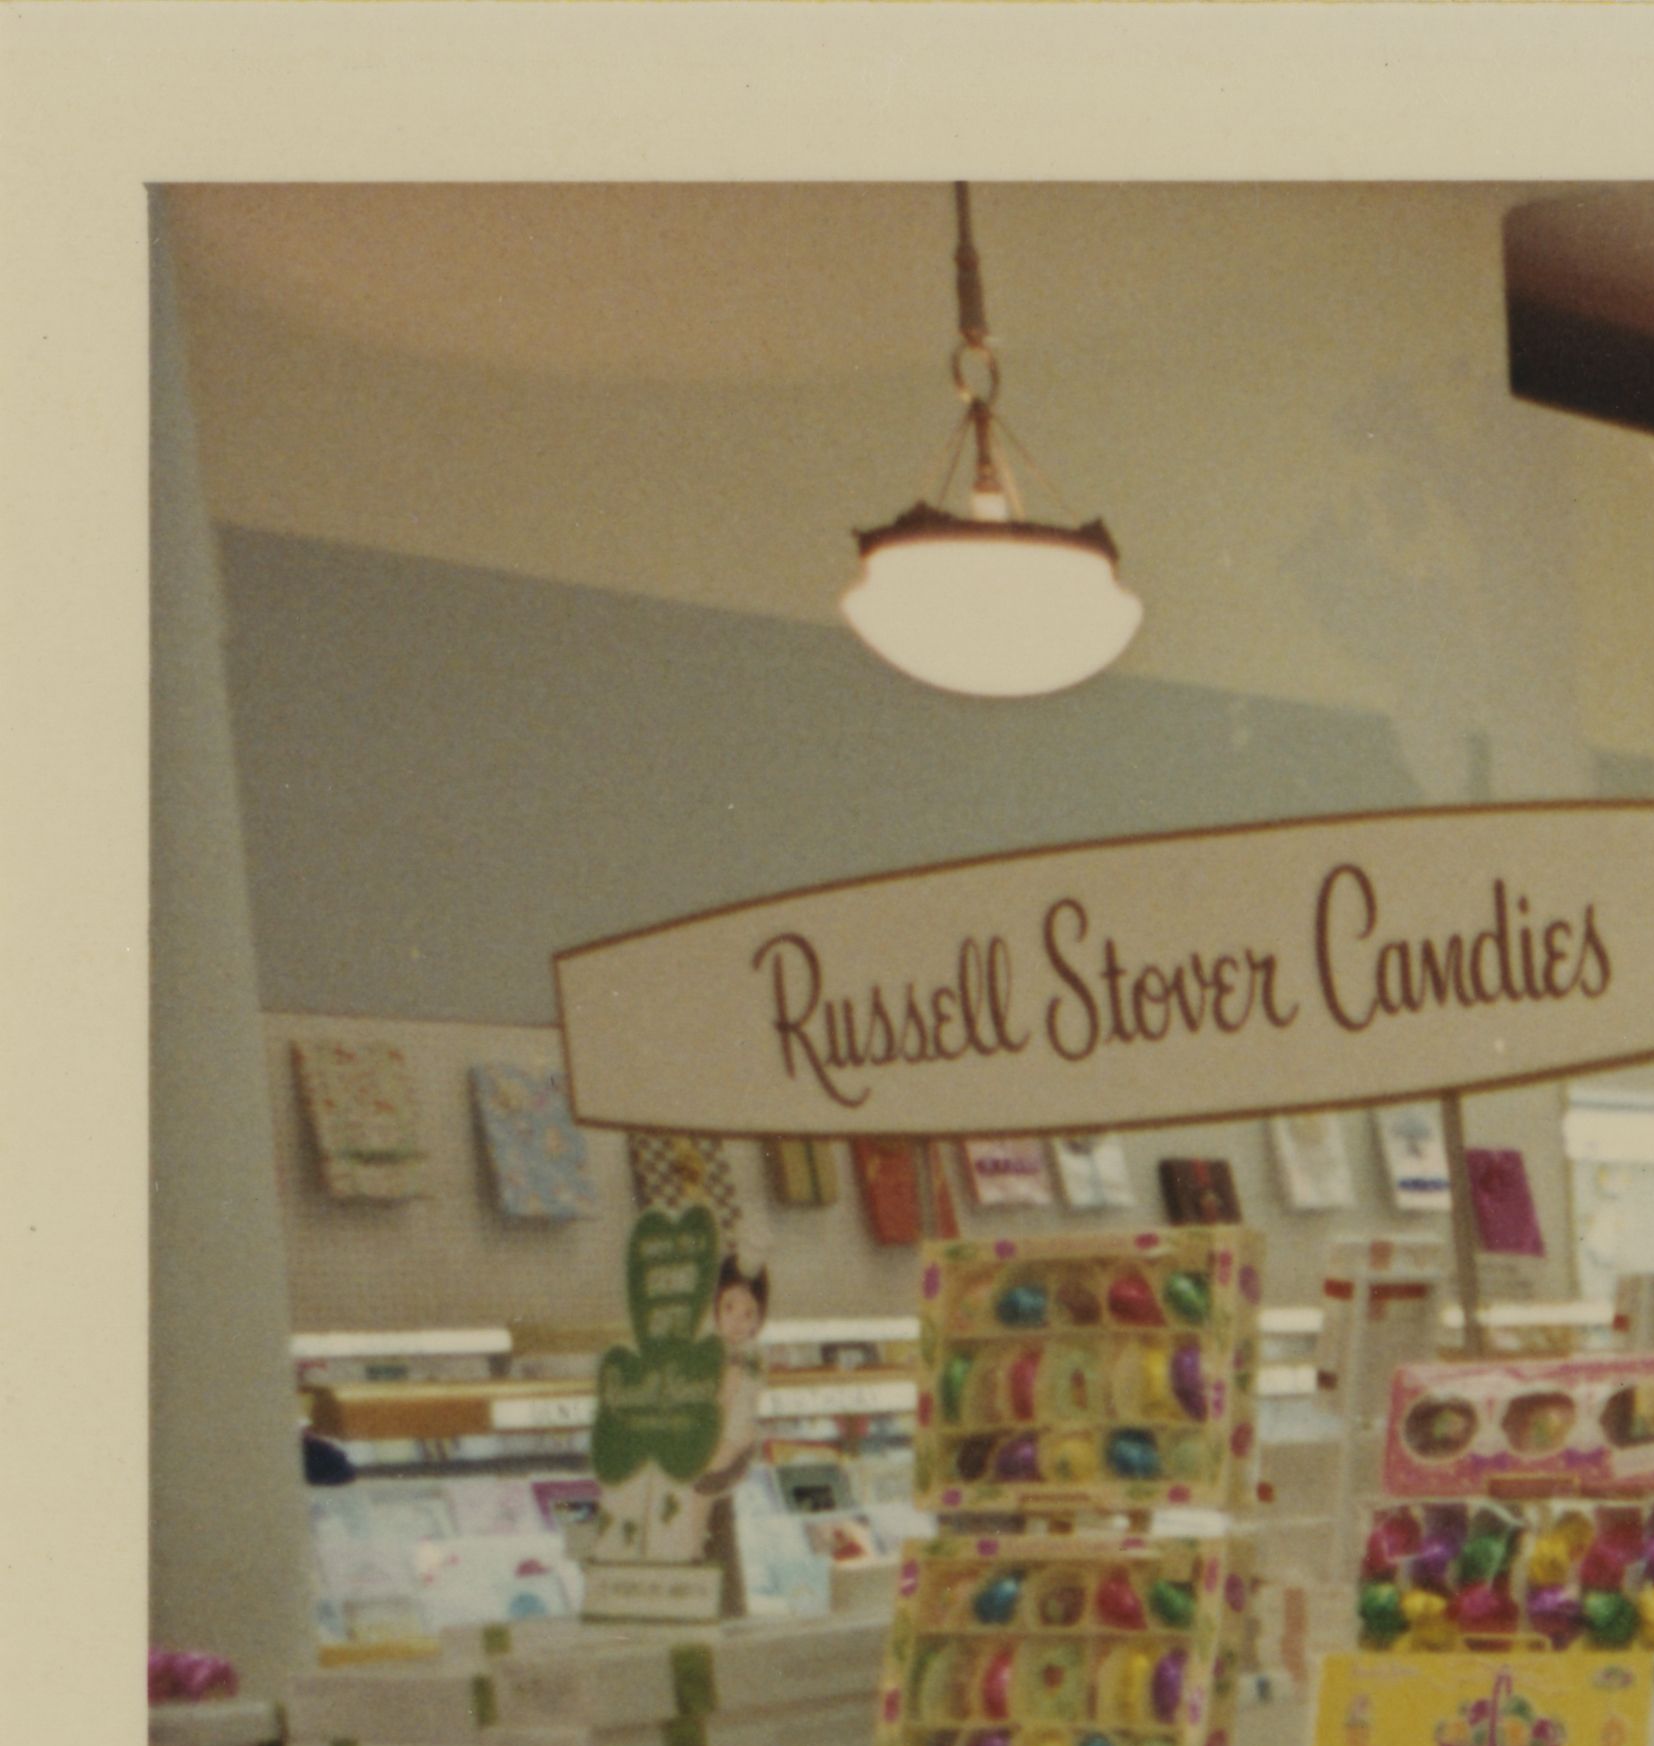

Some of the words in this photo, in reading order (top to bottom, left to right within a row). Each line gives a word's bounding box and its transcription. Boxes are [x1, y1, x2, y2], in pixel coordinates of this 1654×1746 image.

[749, 929, 1030, 1111] Russell
[1040, 895, 1300, 1064] Stover
[1312, 861, 1613, 1034] Candies
